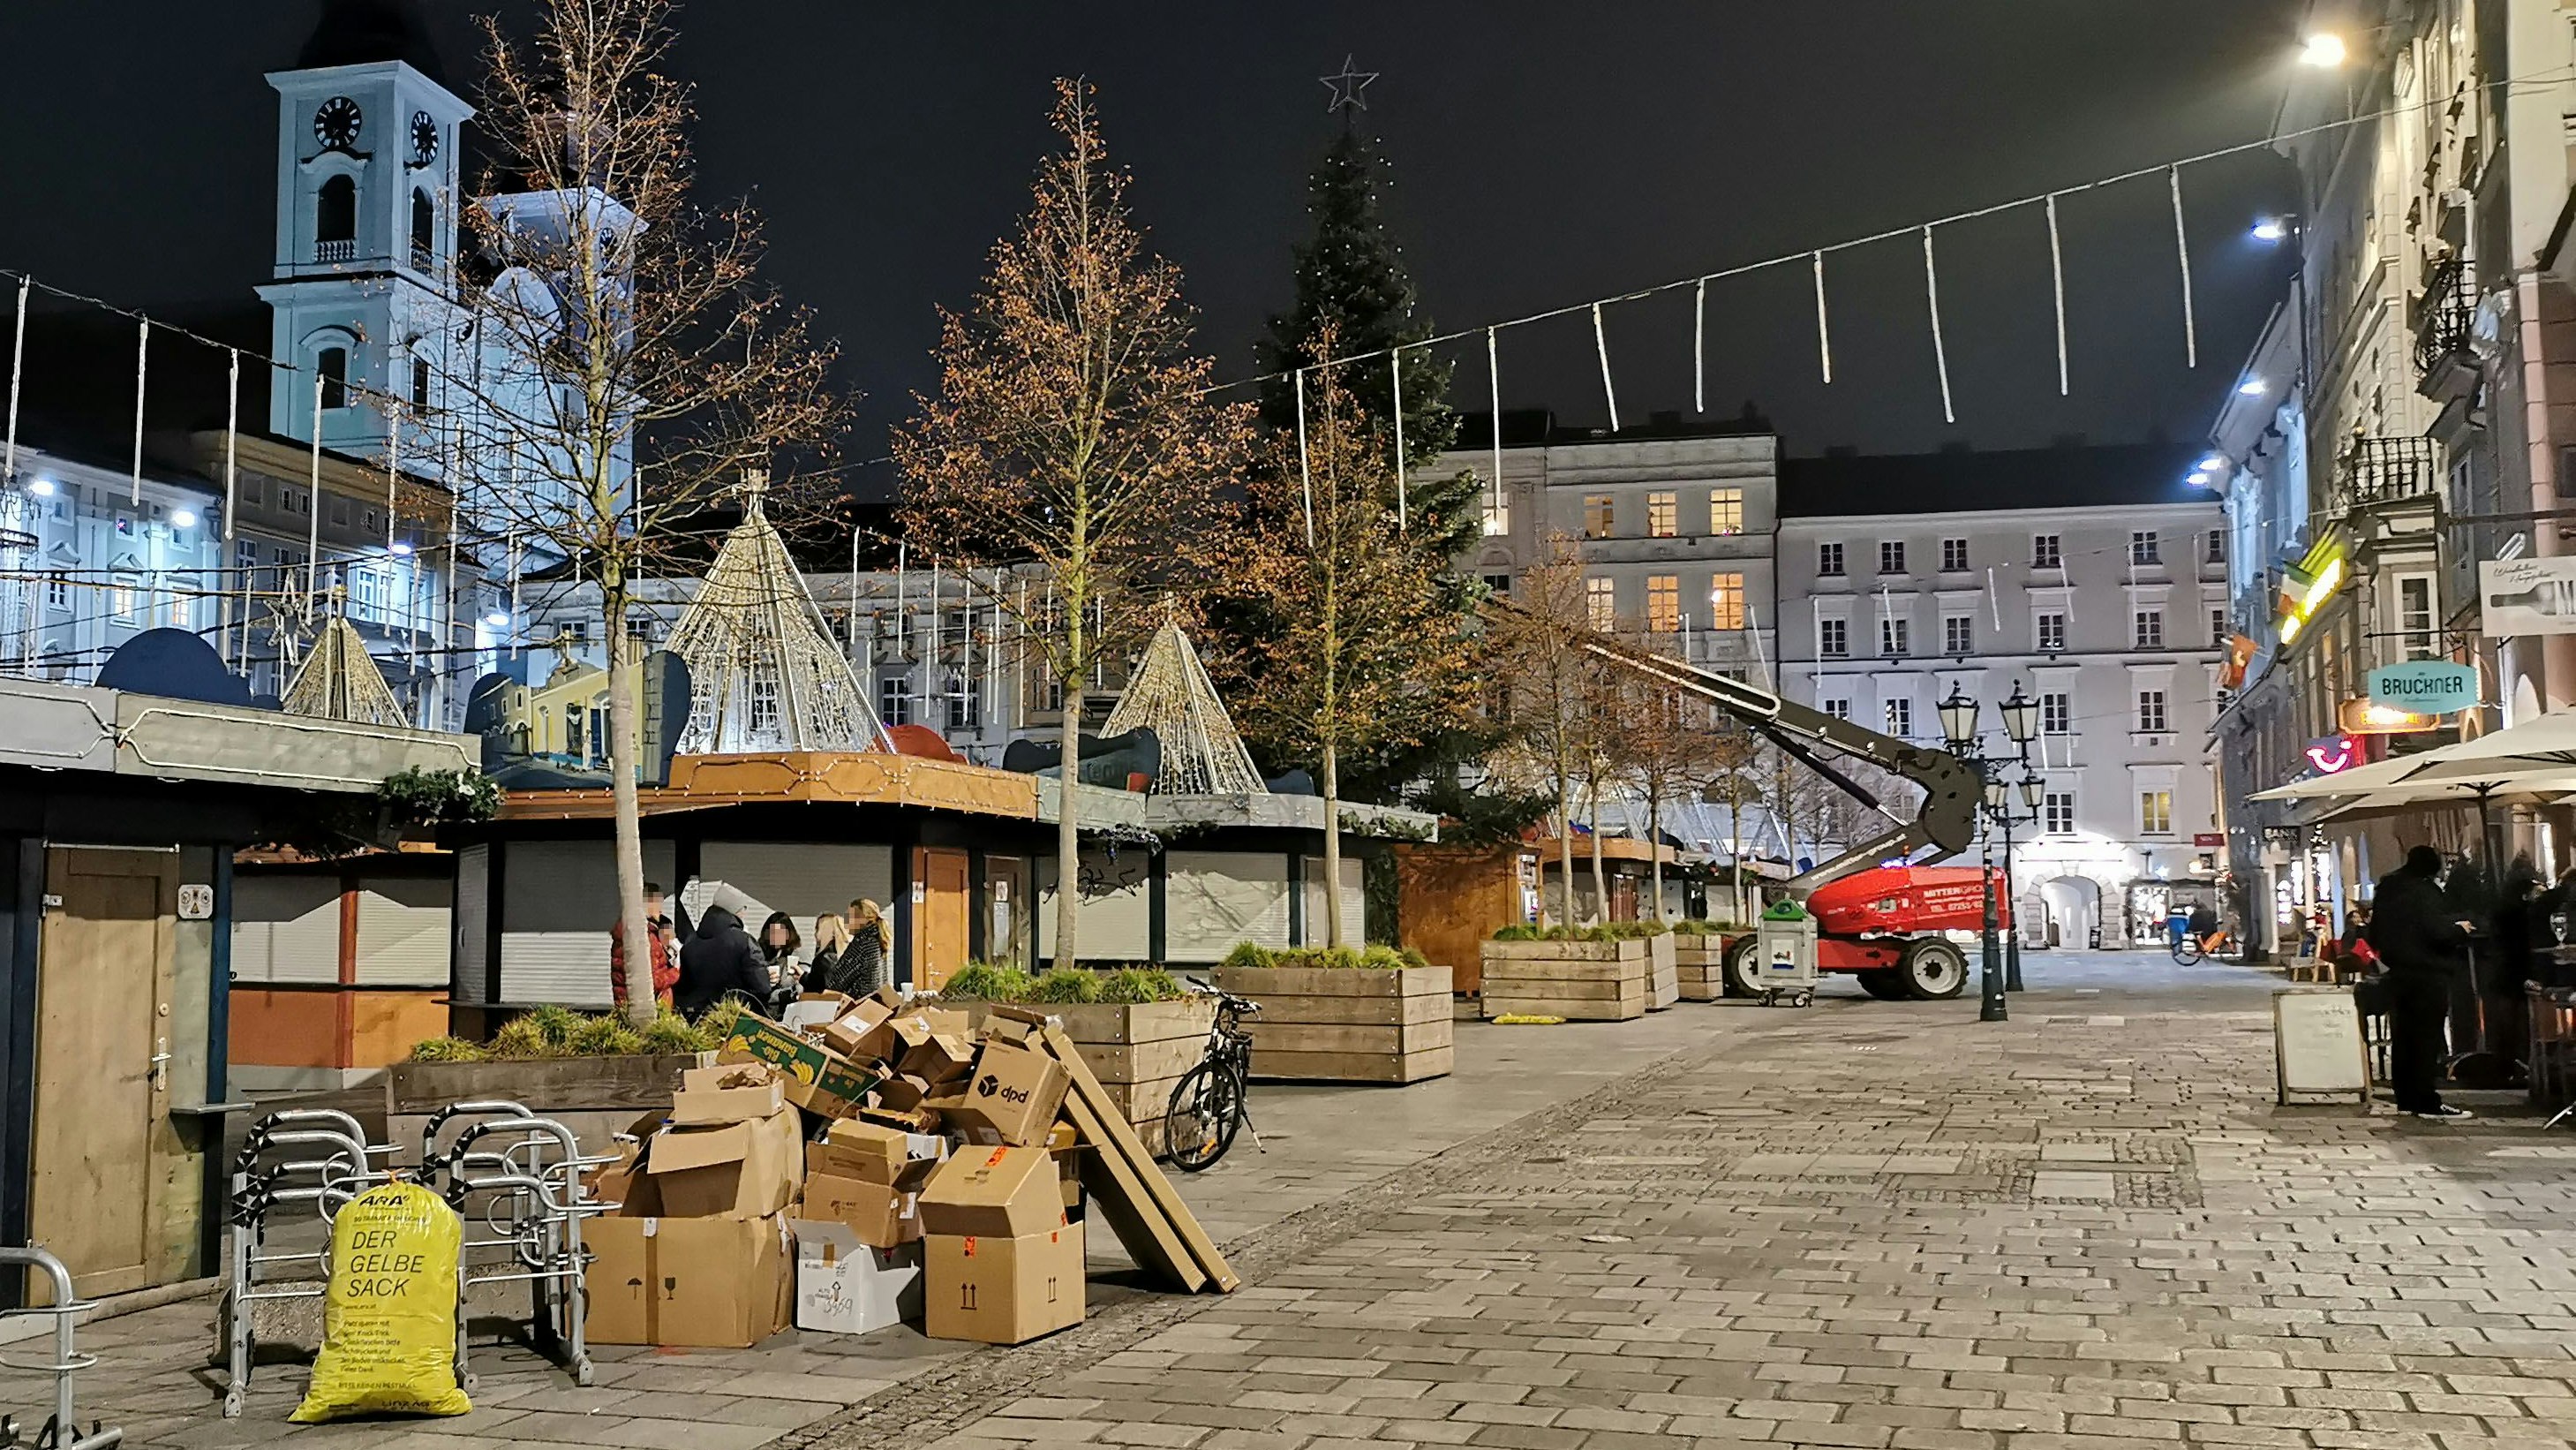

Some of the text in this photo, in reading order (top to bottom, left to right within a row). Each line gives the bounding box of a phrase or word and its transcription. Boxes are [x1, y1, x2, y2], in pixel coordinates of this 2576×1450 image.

[2382, 676, 2463, 695] BRUCKNER
[1000, 1085, 1029, 1103] dpd
[351, 1230, 397, 1250] DER
[350, 1254, 426, 1273] GELBE
[346, 1278, 411, 1297] SACK
